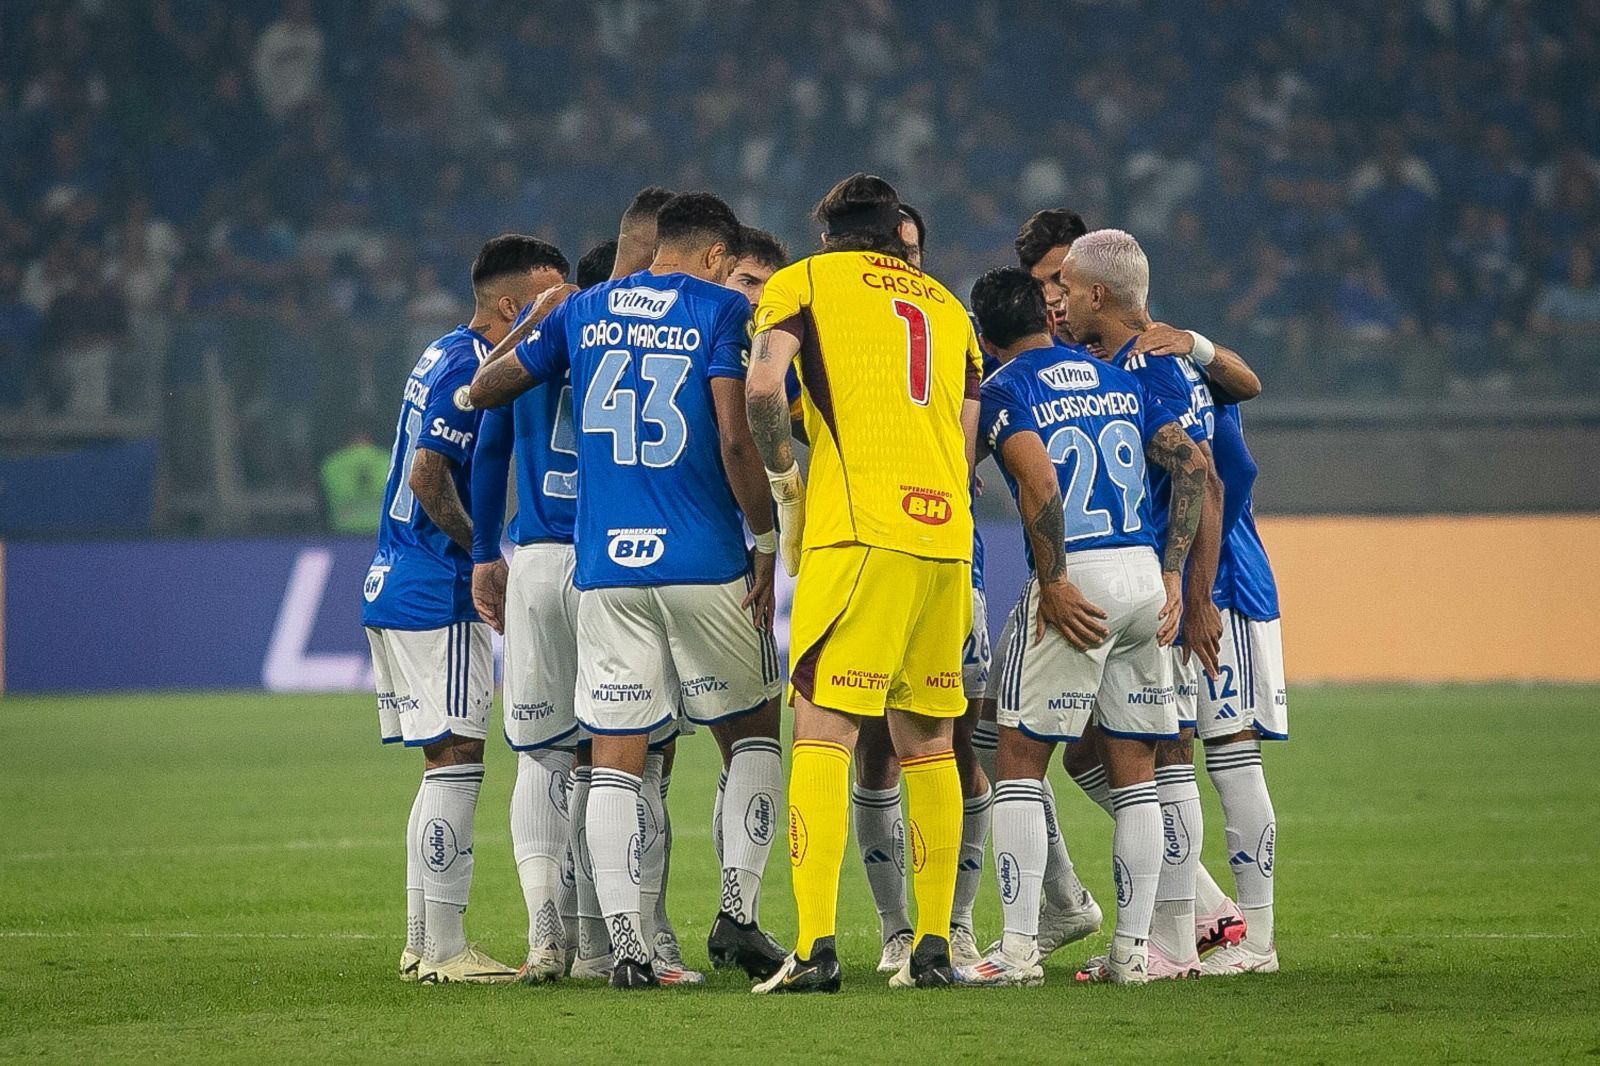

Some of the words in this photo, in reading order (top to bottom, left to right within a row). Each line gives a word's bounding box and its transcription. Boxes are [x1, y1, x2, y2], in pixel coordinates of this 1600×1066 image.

[613, 291, 667, 314] Vilma
[580, 320, 623, 350] JOÃO
[627, 322, 701, 351] MARCELO
[892, 297, 933, 407] 1
[1043, 366, 1095, 386] Vilma
[582, 349, 692, 468] 43
[430, 417, 474, 449] Surf
[1047, 420, 1147, 542] 29
[907, 496, 947, 520] BH
[615, 540, 658, 558] BH
[591, 688, 653, 702] MULTIVIX
[1202, 664, 1239, 702] 12
[1048, 698, 1094, 710] MULTI
